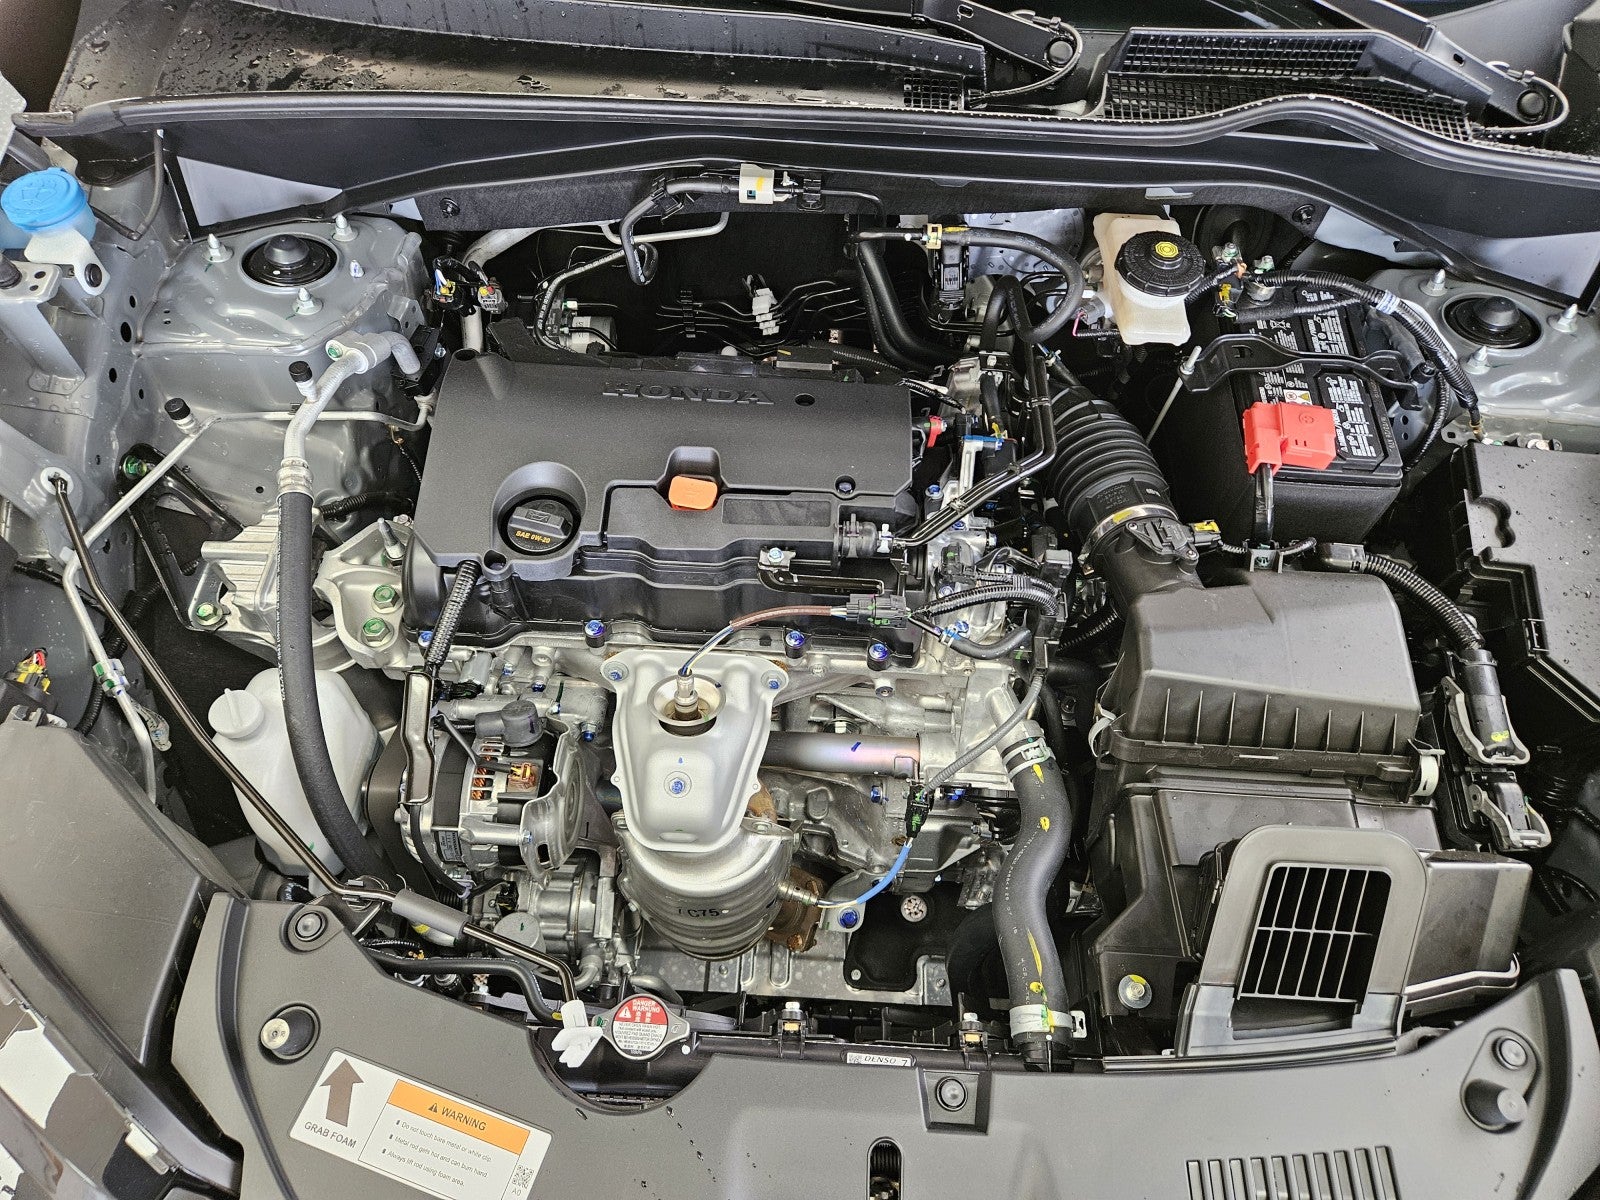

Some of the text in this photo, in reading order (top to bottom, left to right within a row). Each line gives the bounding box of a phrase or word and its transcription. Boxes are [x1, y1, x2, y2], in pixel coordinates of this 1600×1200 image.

[602, 382, 774, 405] HONDA
[516, 530, 551, 543] SAE 0W-20
[864, 1055, 908, 1067] DENSO 7
[441, 1107, 487, 1131] WARNING
[304, 1121, 357, 1148] GRAB FOAM
[401, 1121, 410, 1130] Do
[419, 1128, 433, 1140] touch
[434, 1135, 445, 1144] bare
[446, 1140, 461, 1150] metal
[467, 1149, 482, 1159] white
[387, 1151, 406, 1164] Always
[413, 1160, 423, 1169] rod
[423, 1165, 438, 1176] using
[438, 1170, 452, 1181] foam
[395, 1136, 409, 1146] Metal
[409, 1142, 419, 1151] rod
[418, 1146, 430, 1155] gets
[431, 1151, 440, 1159] hot
[439, 1155, 450, 1163] and
[450, 1159, 461, 1167] can
[461, 1161, 473, 1172] burn
[511, 1188, 522, 1197] A0
